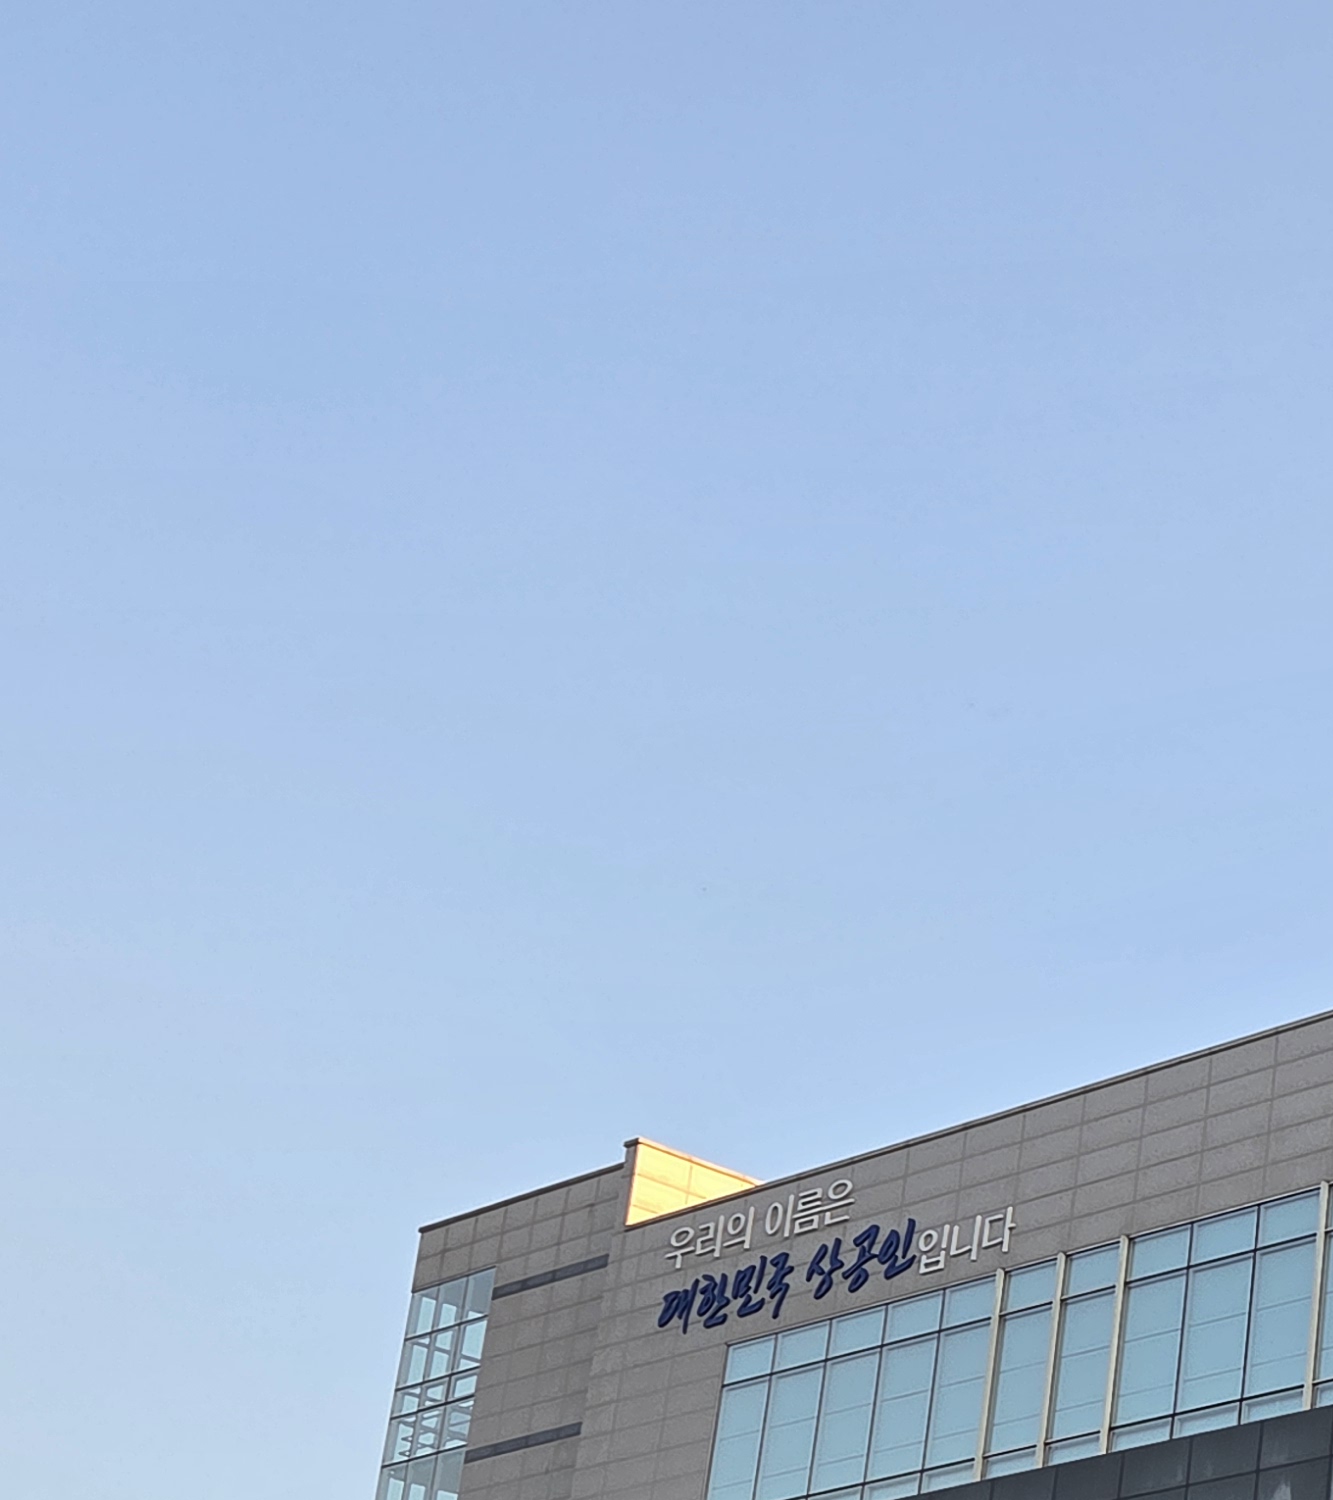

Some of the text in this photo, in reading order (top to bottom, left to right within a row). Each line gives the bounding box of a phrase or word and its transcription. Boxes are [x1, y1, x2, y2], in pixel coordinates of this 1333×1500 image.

[657, 1206, 1017, 1334] 대한민국 상공인입니다
[664, 1179, 855, 1268] 우리의 이름은
